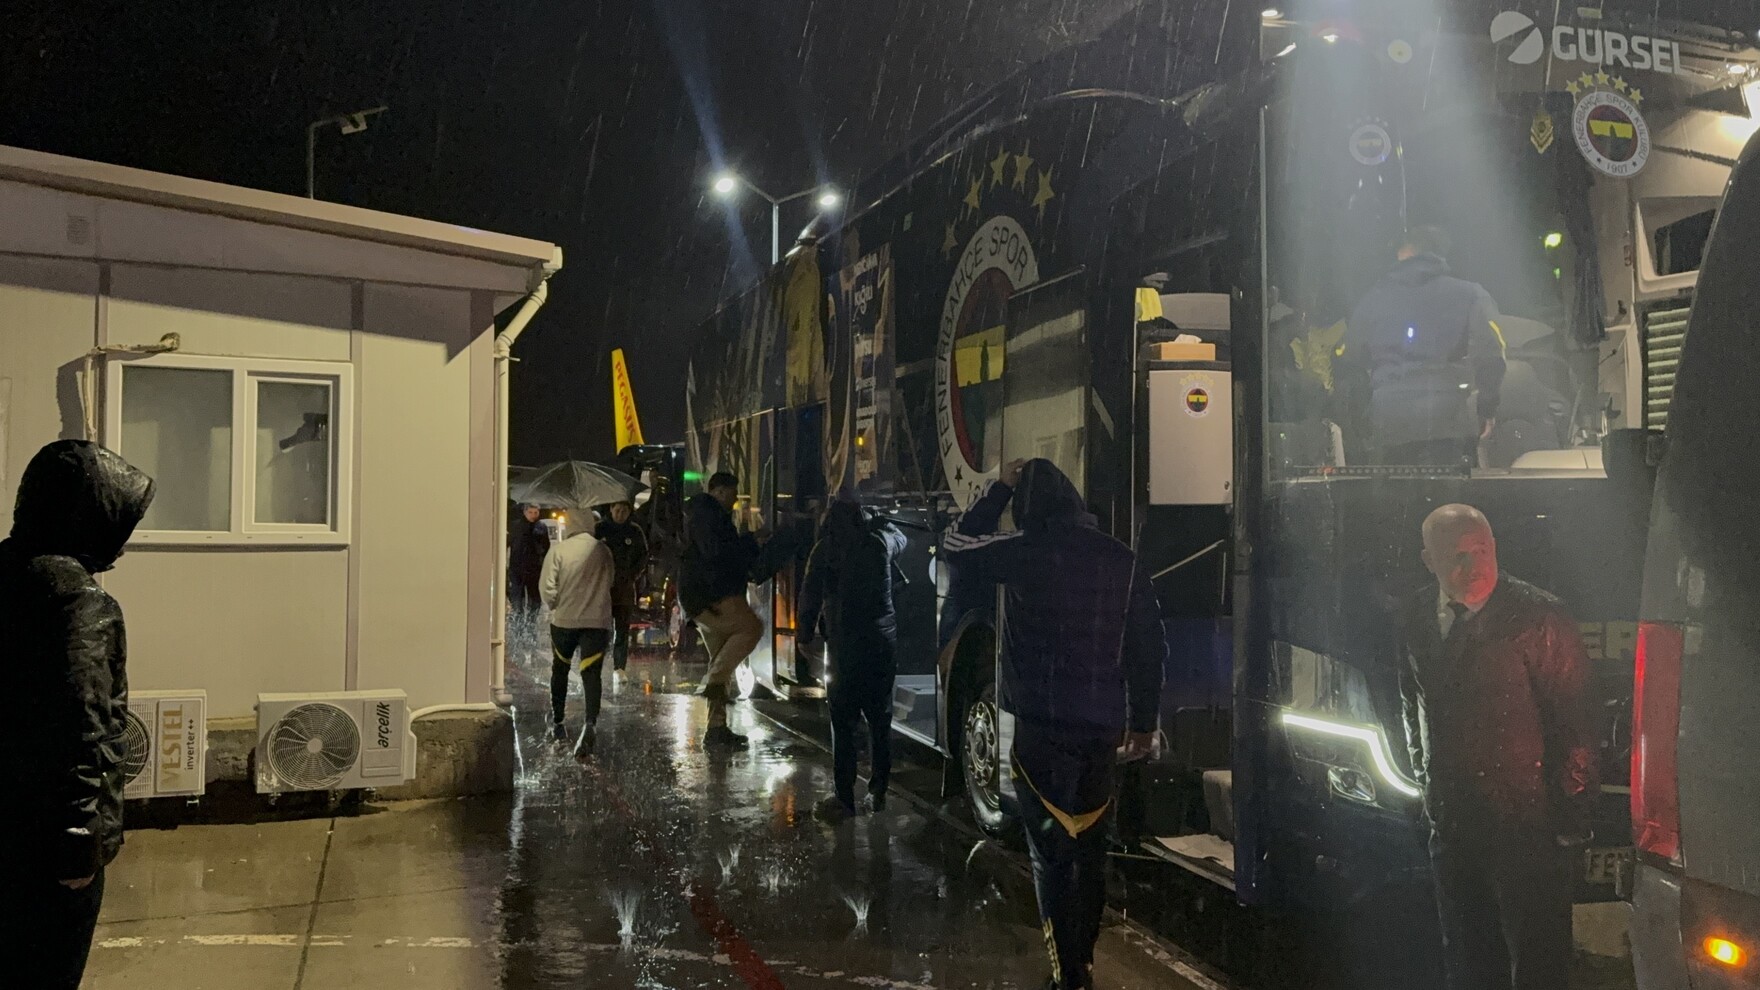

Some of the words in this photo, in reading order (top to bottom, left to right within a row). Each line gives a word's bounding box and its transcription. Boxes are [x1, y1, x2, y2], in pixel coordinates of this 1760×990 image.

[1552, 25, 1682, 74] GÜRSEL
[1606, 93, 1633, 115] SPOR
[1606, 162, 1628, 174] 1907
[933, 236, 983, 458] FENERBAHÇE
[989, 225, 1028, 282] SPOR
[160, 703, 183, 787] VESTEL
[376, 701, 392, 749] arçelik
